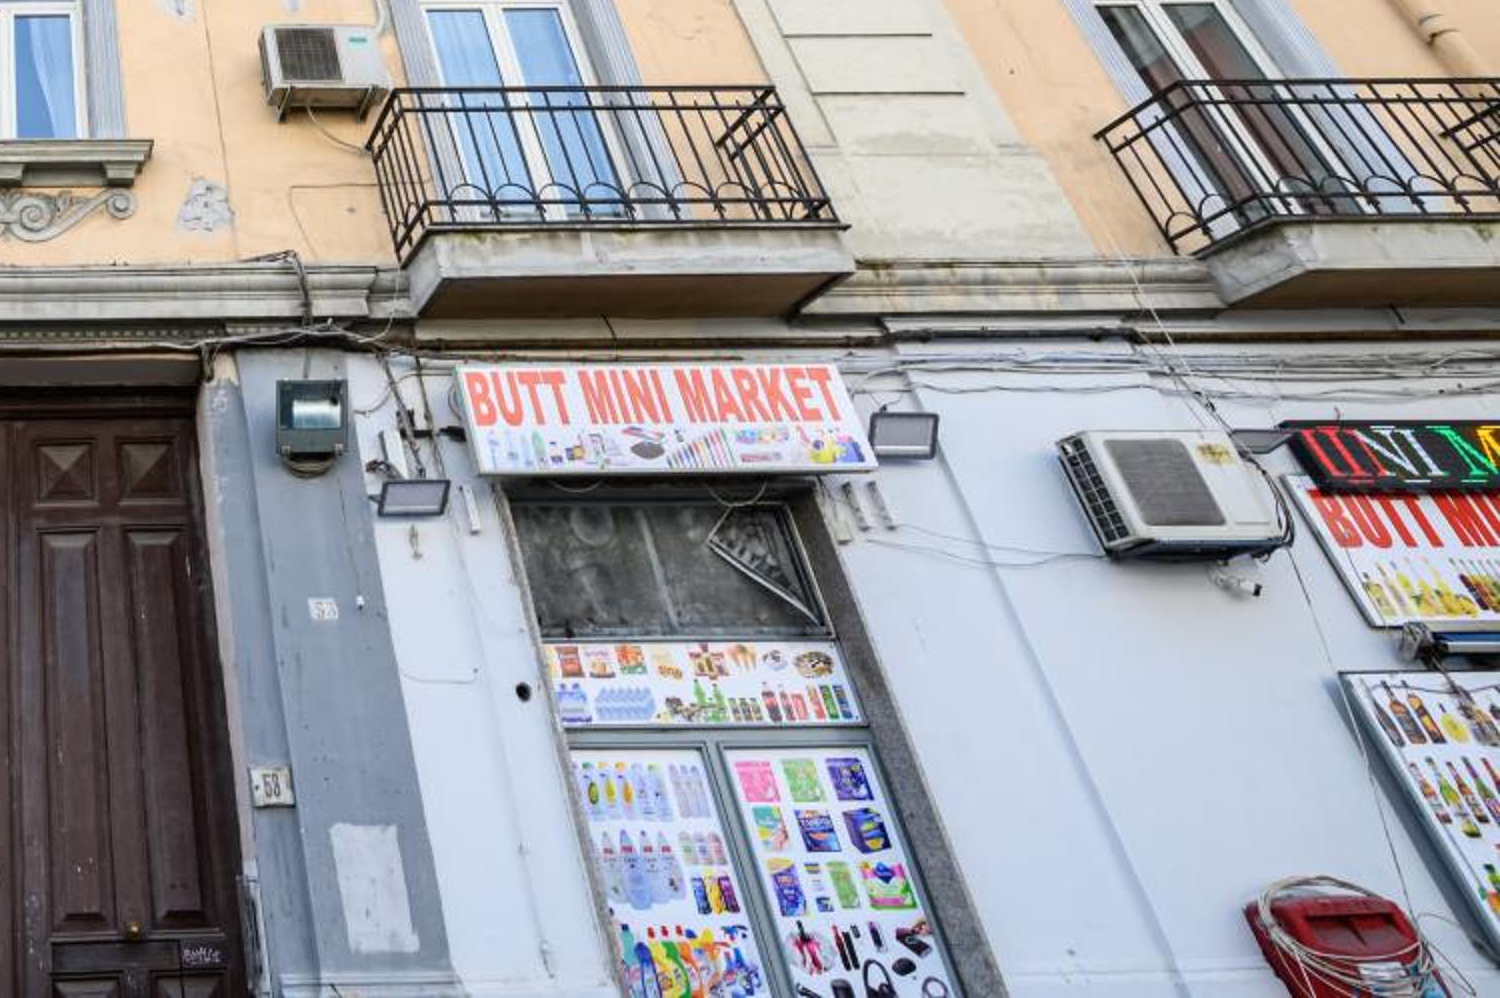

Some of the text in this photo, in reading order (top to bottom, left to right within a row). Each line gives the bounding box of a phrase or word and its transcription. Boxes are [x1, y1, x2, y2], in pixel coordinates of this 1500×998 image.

[465, 367, 842, 427] BUTT MINI MARKET
[1307, 488, 1446, 549] BUTT
